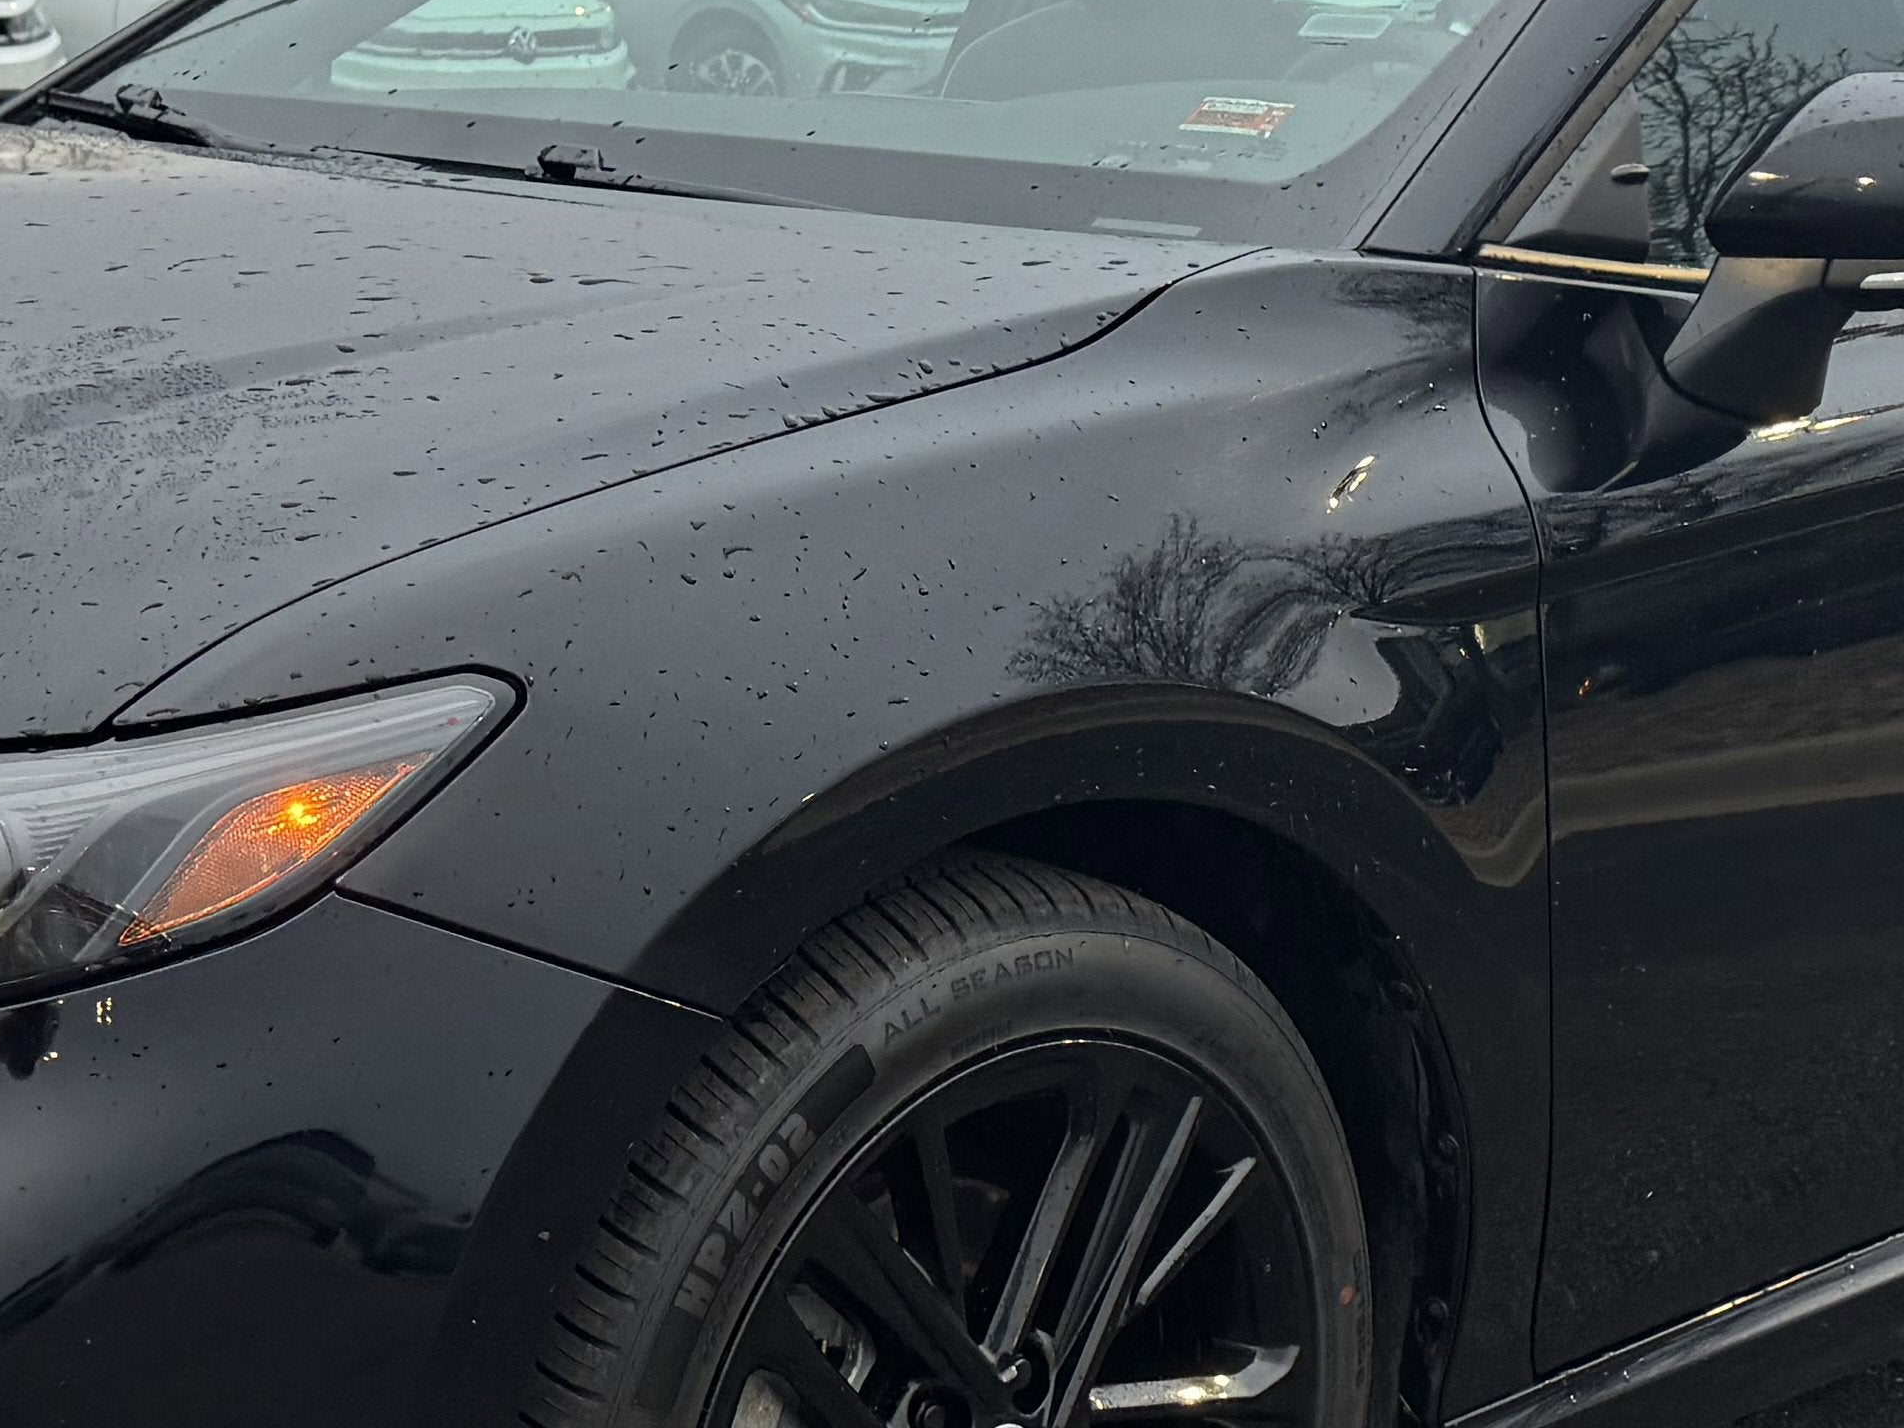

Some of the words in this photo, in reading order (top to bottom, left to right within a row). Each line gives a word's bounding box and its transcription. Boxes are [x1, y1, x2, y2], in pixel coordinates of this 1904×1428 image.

[884, 997, 941, 1048] ALL
[951, 947, 1074, 1000] SEASON
[673, 1113, 817, 1318] HPZ-02
